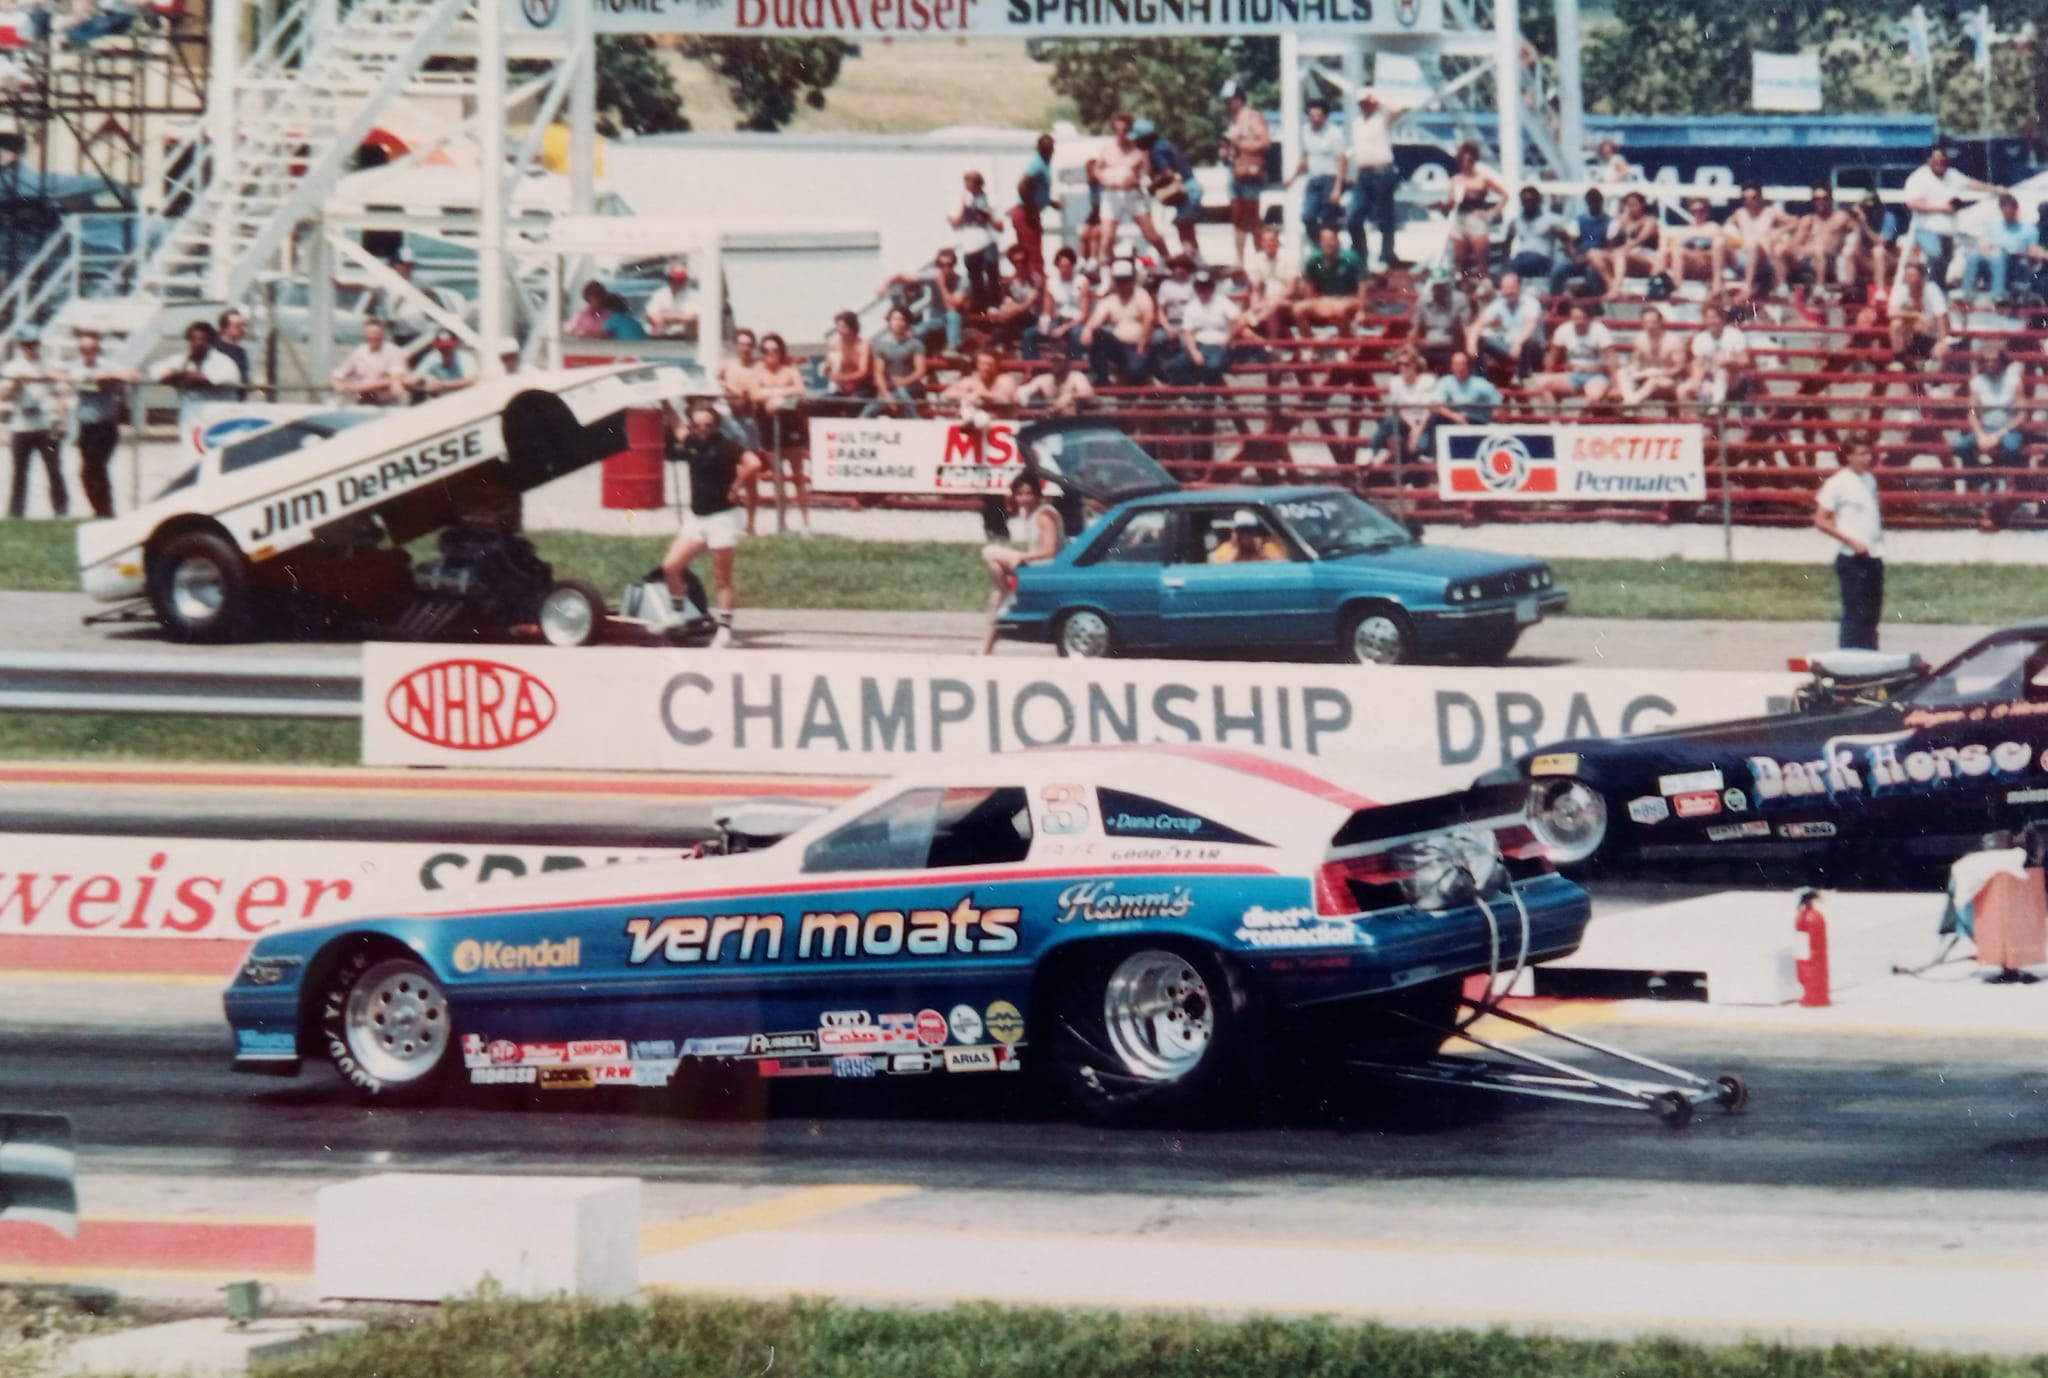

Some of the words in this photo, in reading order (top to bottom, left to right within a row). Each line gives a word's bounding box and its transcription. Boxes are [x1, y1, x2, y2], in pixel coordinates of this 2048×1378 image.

[734, 0, 976, 31] Budweiser
[1006, 0, 1374, 24] SPRINGNATIONALS
[825, 431, 902, 446] MULTIPLE
[1571, 437, 1684, 461] LOCTITE
[826, 449, 878, 461] SPARK
[826, 464, 916, 479] DISCHARGE
[1574, 470, 1690, 493] Permatex
[249, 486, 328, 542] JIM
[337, 428, 484, 508] DePASSE
[400, 662, 545, 748] NHRA
[660, 672, 1353, 757] CHAMPIONSHIP
[1748, 732, 1880, 805] Dark
[1866, 741, 2032, 797] Horse
[1056, 880, 1195, 924] Hamm's
[625, 913, 785, 965] vern
[798, 892, 1021, 958] moats
[483, 937, 581, 969] Kendall
[572, 1042, 622, 1057] SIMPSON
[952, 1052, 990, 1064] ARIAS
[594, 1066, 634, 1079] TRW
